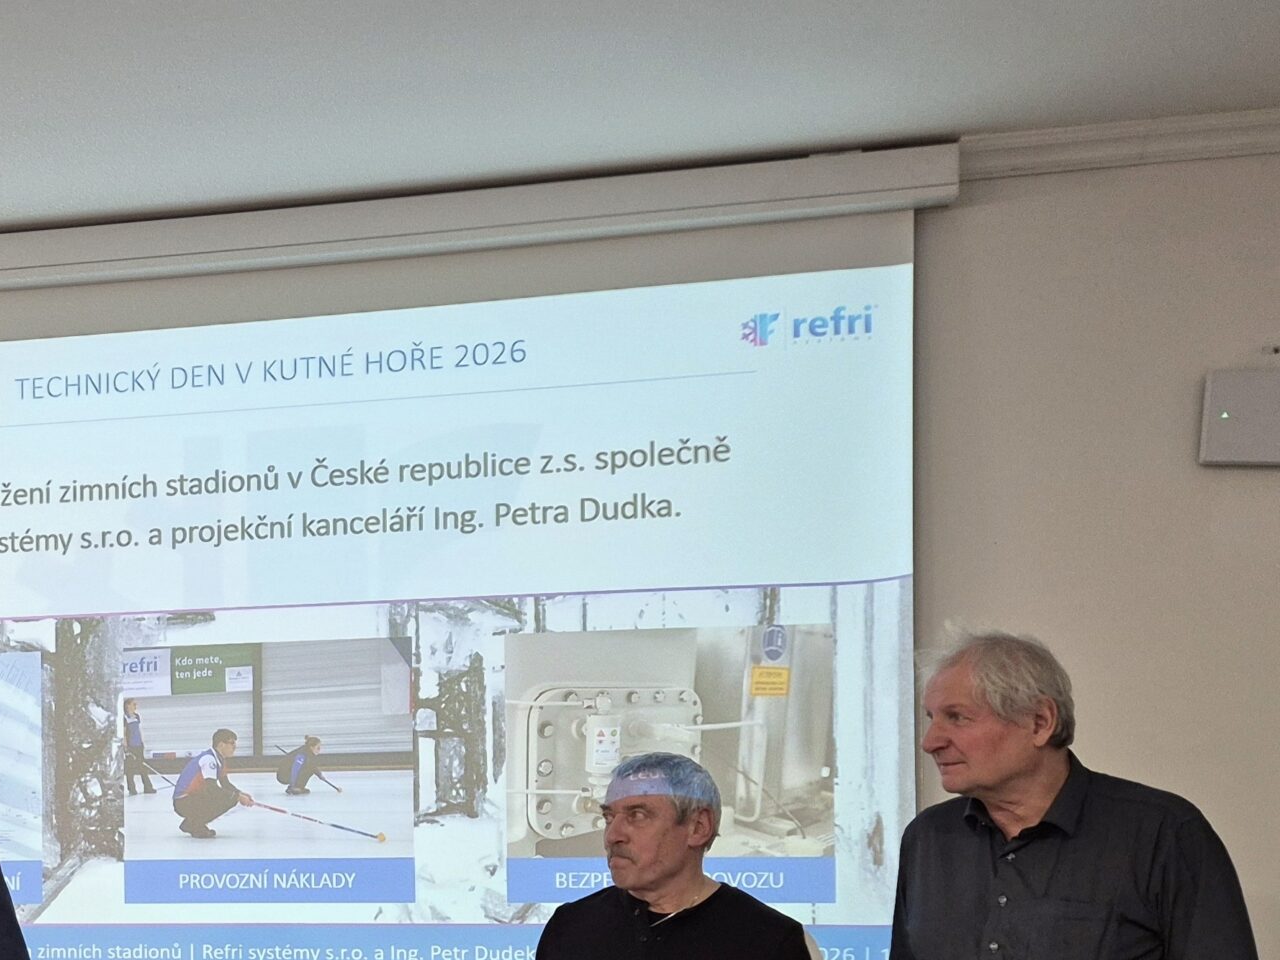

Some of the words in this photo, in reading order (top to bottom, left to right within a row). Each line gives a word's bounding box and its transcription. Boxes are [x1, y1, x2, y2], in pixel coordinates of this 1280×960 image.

[792, 304, 872, 339] refri
[14, 362, 161, 400] TECHNICKÝ
[170, 363, 225, 390] DEN
[235, 361, 253, 384] V
[263, 347, 354, 382] KUTNÉ
[365, 341, 444, 375] HOŘE
[454, 339, 527, 368] 2026
[59, 473, 157, 503] zimních
[165, 464, 279, 496] stadionů
[287, 471, 303, 489] v
[310, 457, 389, 487] České
[398, 451, 531, 486] republice
[539, 453, 585, 475] z.s.
[594, 435, 731, 475] společně
[80, 527, 140, 550] s.r.o.
[148, 527, 162, 546] a
[171, 513, 294, 549] projekční
[302, 506, 425, 538] kanceláří
[434, 506, 483, 534] Ing.
[495, 501, 569, 527] Petra
[580, 492, 682, 522] Dudka.
[122, 656, 158, 674] refri
[175, 657, 193, 667] Kdo
[195, 655, 222, 665] mete,
[175, 671, 191, 679] ten
[193, 668, 213, 680] jede
[179, 868, 268, 889] PROVOZNÍ
[273, 868, 356, 889] NÁKLADY
[555, 872, 613, 888] BEZPE
[37, 944, 102, 960] zimních
[107, 942, 182, 960] stadionů
[202, 943, 243, 960] Refri
[325, 948, 368, 960] s.r.o.
[373, 949, 384, 960] a
[431, 945, 468, 960] Petr
[475, 945, 536, 960] Dudek
